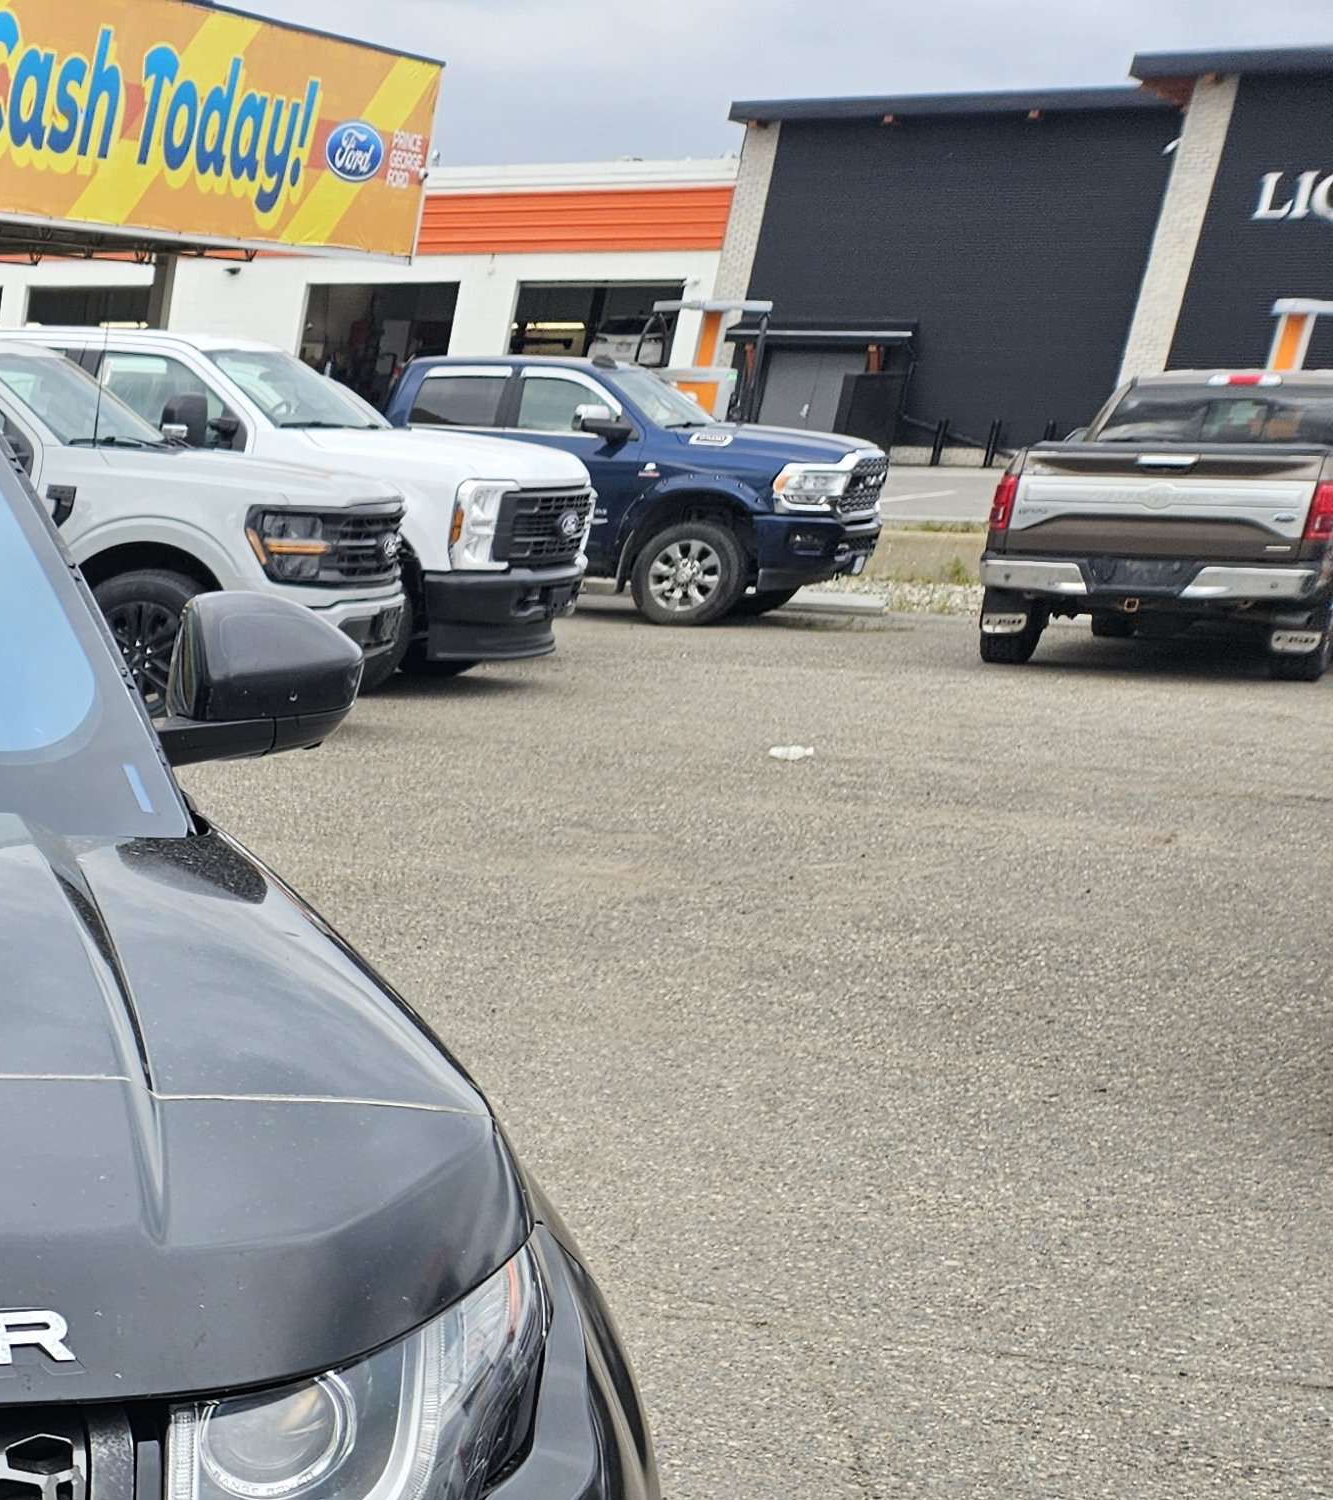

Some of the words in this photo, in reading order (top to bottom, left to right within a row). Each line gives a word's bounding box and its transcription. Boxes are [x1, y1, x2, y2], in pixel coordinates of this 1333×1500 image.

[137, 46, 319, 214] Today!
[392, 130, 422, 151] PRINCE
[332, 127, 377, 174] Ford
[389, 150, 424, 170] GEORGE
[386, 168, 409, 187] FORD
